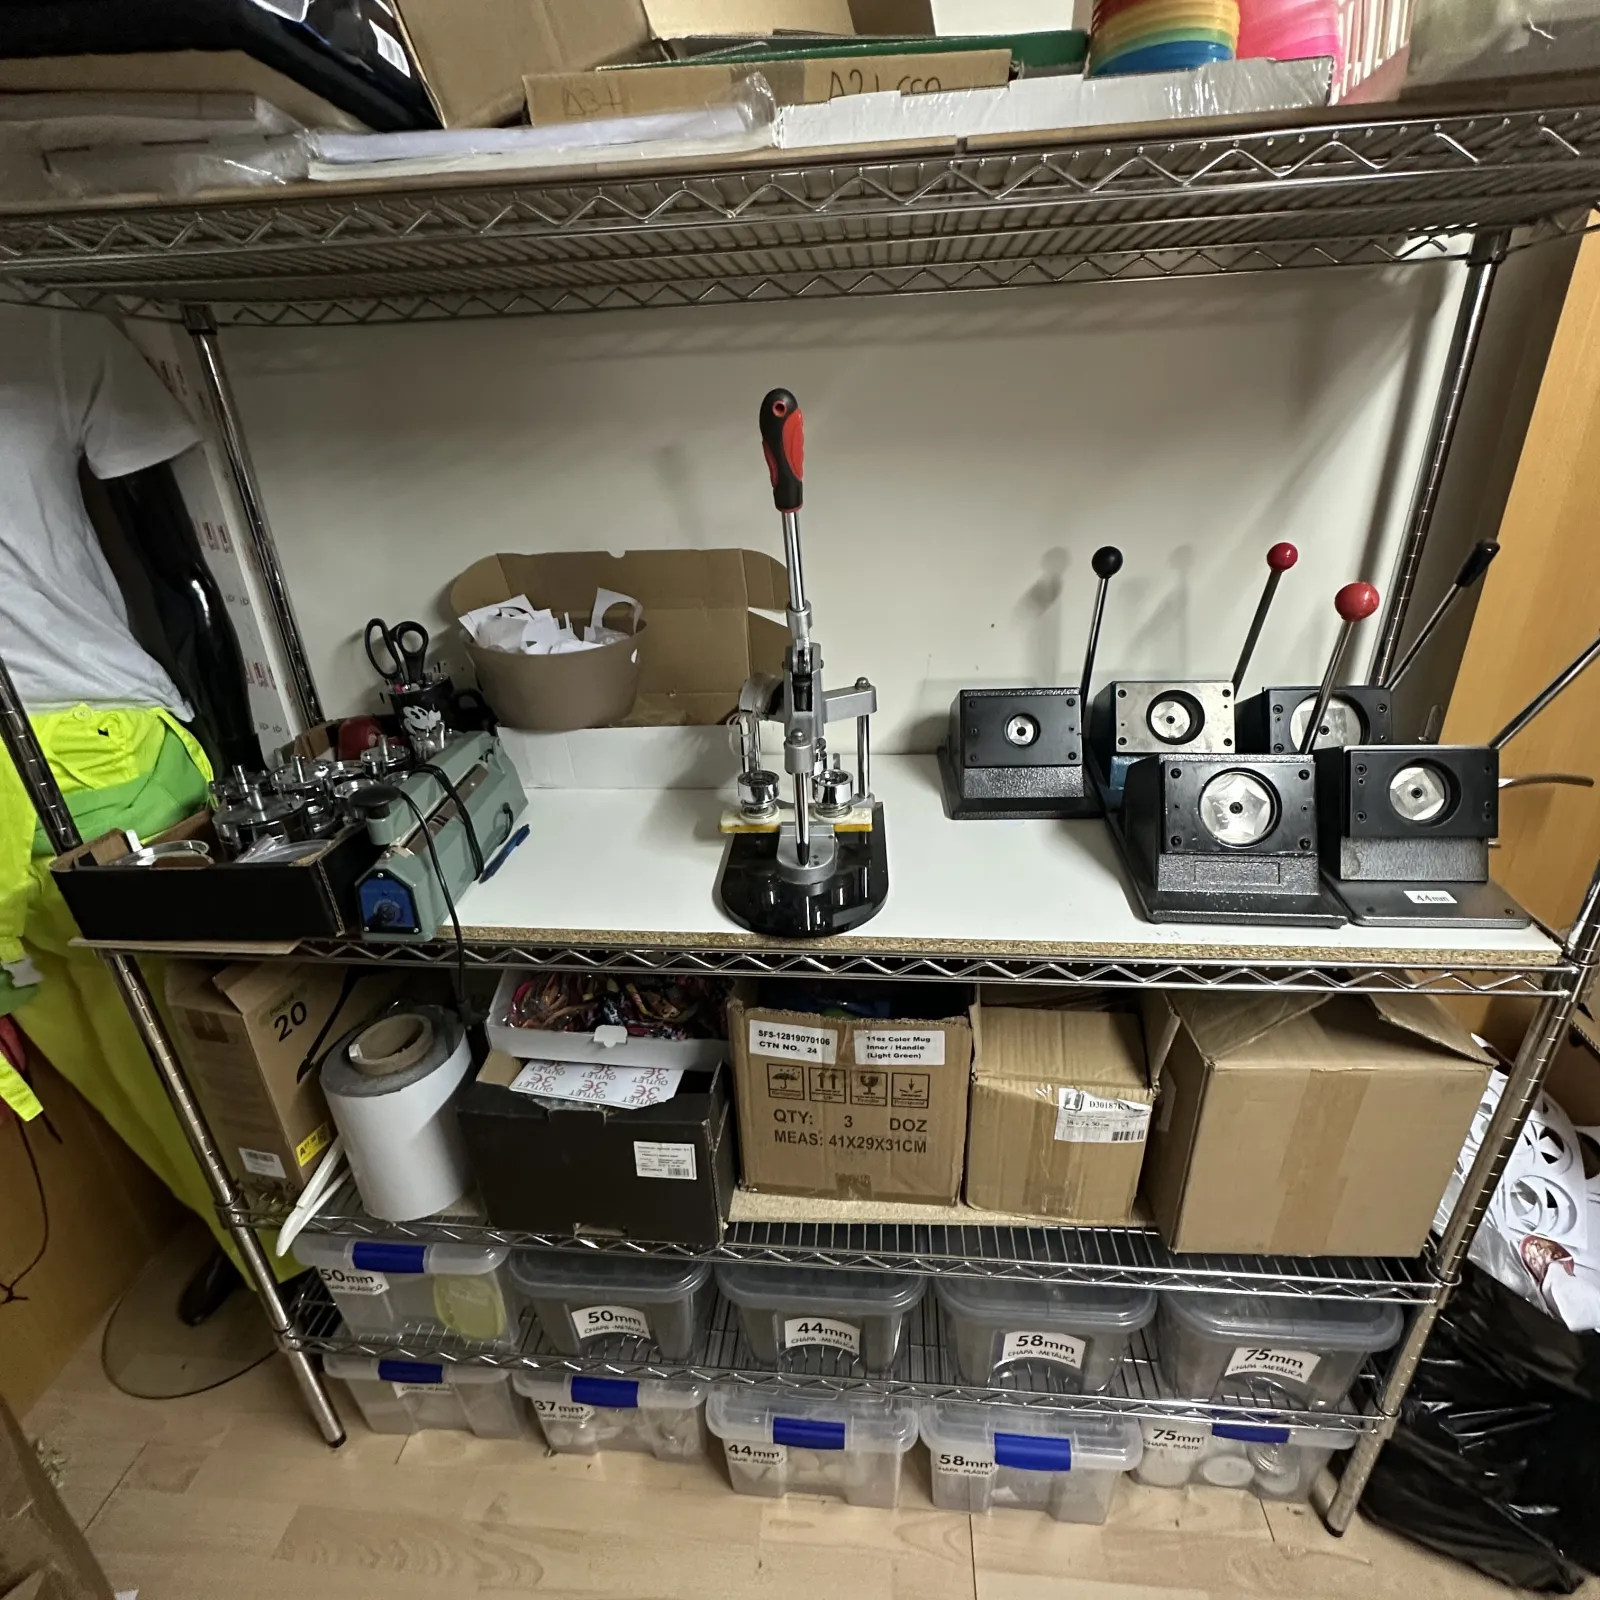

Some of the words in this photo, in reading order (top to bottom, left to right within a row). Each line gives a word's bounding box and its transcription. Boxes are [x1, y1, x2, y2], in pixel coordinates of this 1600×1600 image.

[274, 1001, 307, 1042] 20
[758, 1029, 830, 1045] SFS-12819070106
[759, 1040, 779, 1049] CTN
[782, 1043, 800, 1052] NO.
[773, 1109, 814, 1125] QTY:
[843, 1115, 854, 1128] 3
[889, 1117, 928, 1133] DOZ
[774, 1129, 824, 1146] MEAS:
[828, 1134, 927, 1153] 41X29X31CM
[320, 1268, 375, 1283] 50mm
[588, 1310, 641, 1326] 50mm
[797, 1322, 853, 1341] 44mm
[1016, 1334, 1075, 1355] 58mm
[1007, 1349, 1034, 1357] CHAPA
[1244, 1348, 1304, 1369] 75mm
[1153, 1428, 1204, 1443] 75mm
[728, 1444, 779, 1458] 44mm
[939, 1453, 993, 1468] 58mm
